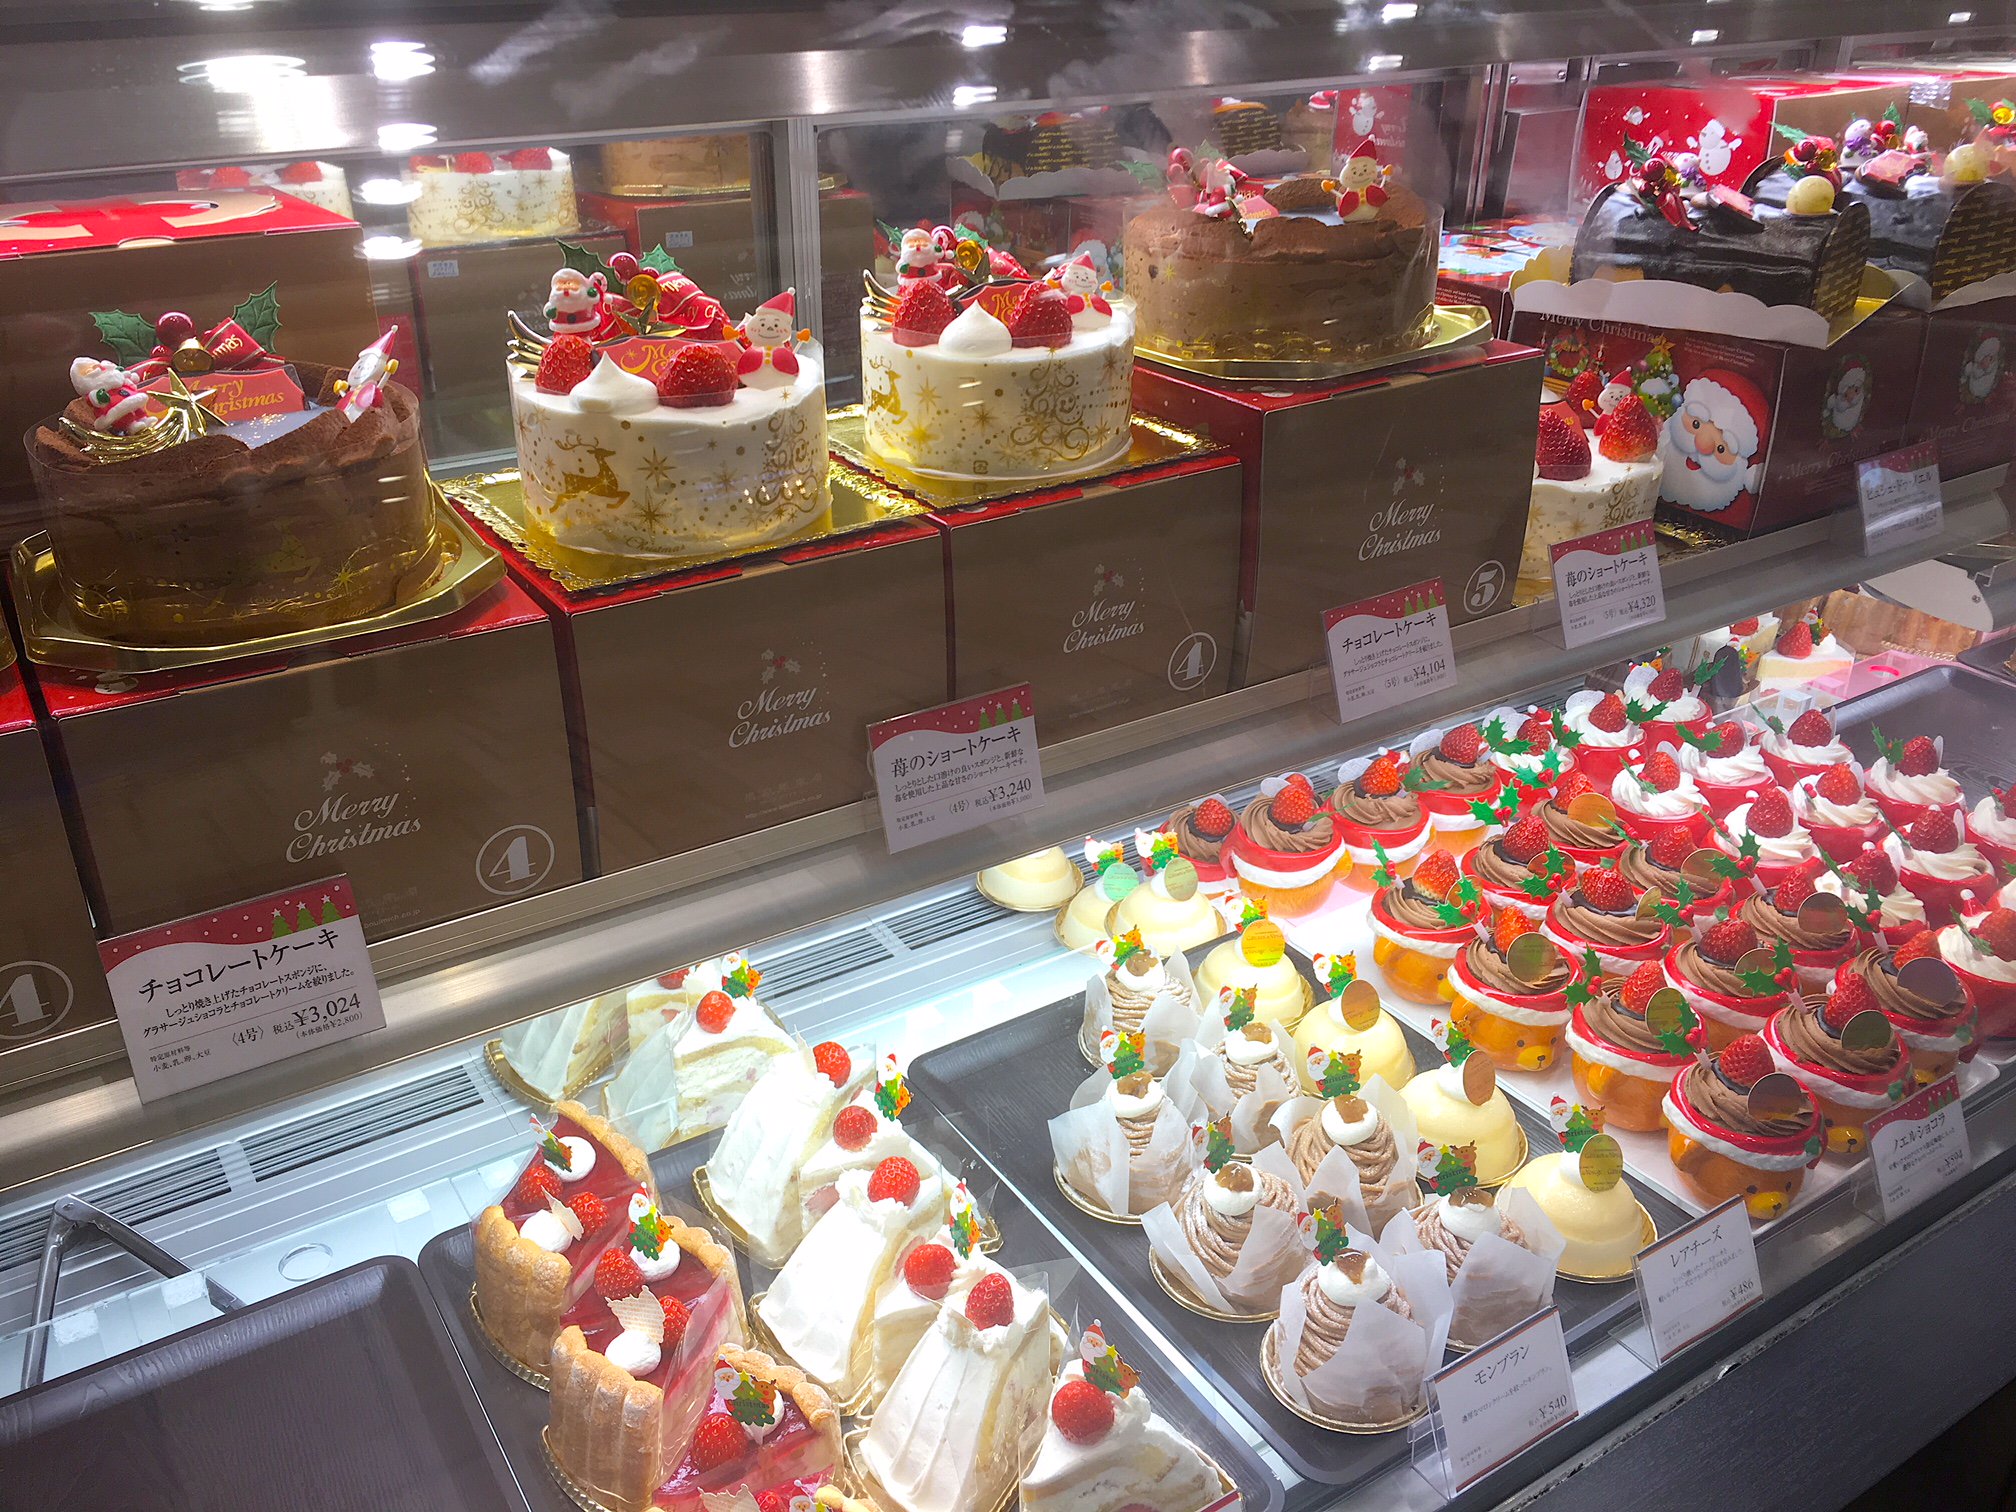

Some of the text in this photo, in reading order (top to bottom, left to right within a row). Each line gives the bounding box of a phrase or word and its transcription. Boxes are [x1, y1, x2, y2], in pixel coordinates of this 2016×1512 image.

[1369, 498, 1435, 532] Merry
[1358, 529, 1441, 562] Christmas
[1470, 568, 1498, 607] 5
[1565, 551, 1648, 588] 苺のショートケーキ
[1071, 598, 1136, 628] Merry
[1341, 612, 1437, 655] チョコレートケーキ
[1063, 622, 1145, 654] Christmas
[1174, 641, 1204, 682] 4
[736, 686, 817, 720] Merry
[728, 709, 832, 749] Christmas
[891, 726, 1021, 778] 苺のショートケーキ
[293, 792, 400, 832] Merry
[285, 817, 422, 863] Christmas
[488, 835, 537, 884] 4
[138, 928, 339, 1003] チョコレートケーキ
[142, 968, 356, 1038] グラサージュショコラとチョコレートクリームを絞りました。
[165, 963, 328, 1018] しっとり焼き上げたチョコレートスポンジに、
[1893, 1112, 1946, 1154] ノエルショコラ
[1670, 1224, 1723, 1268] レアチーズ
[1473, 1344, 1530, 1386] モンブラン
